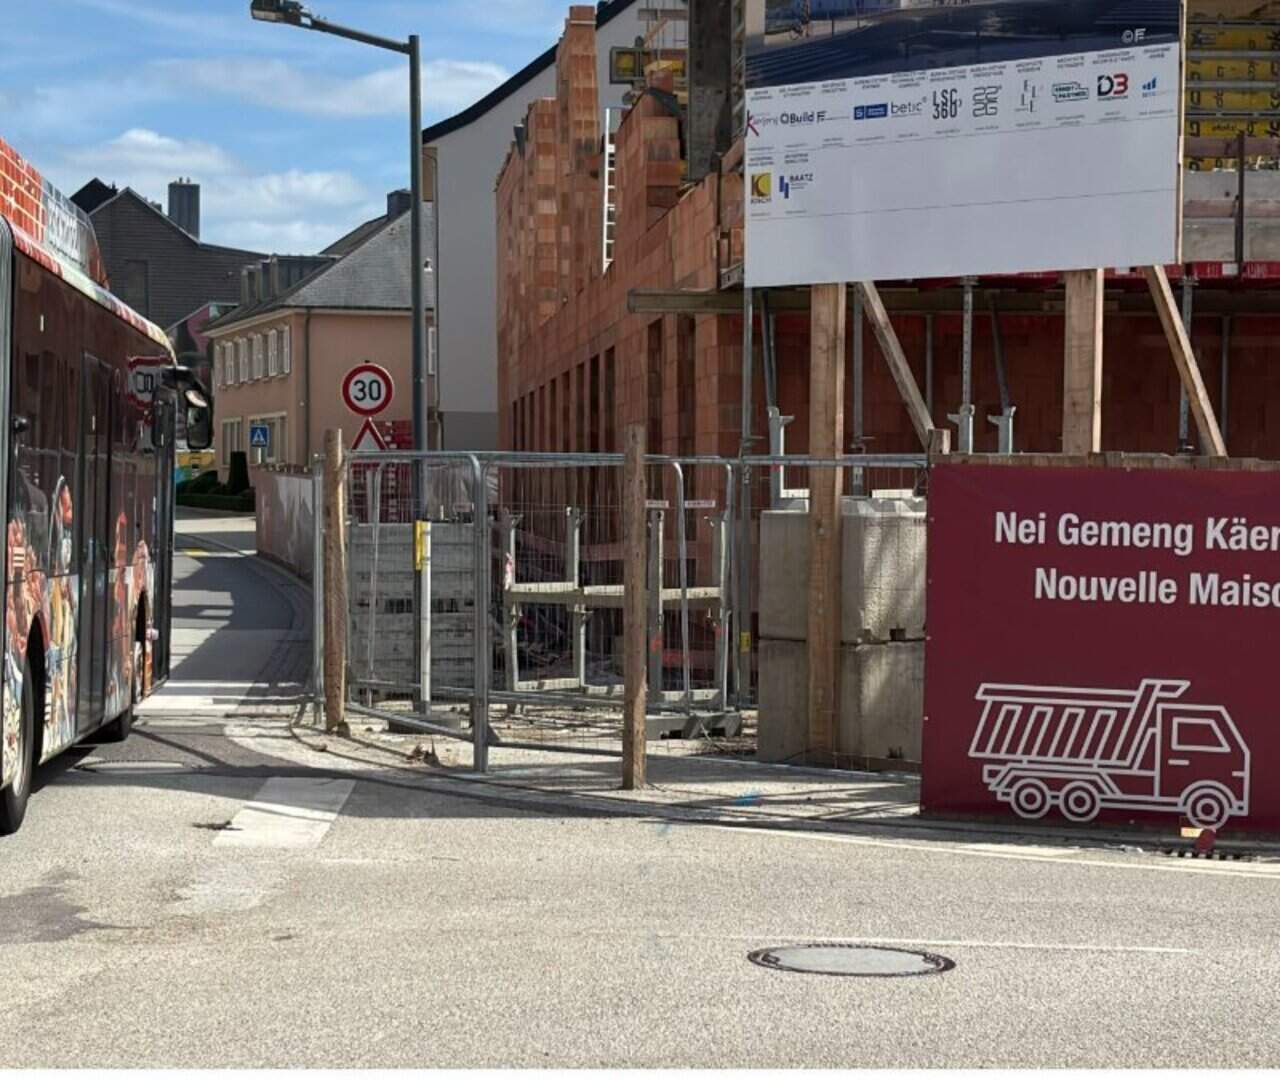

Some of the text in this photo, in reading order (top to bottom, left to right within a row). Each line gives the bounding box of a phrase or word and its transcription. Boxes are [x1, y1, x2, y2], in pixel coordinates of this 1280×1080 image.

[353, 379, 382, 402] 30
[994, 511, 1047, 545] Nei
[1057, 512, 1194, 556] Gemeng
[1034, 567, 1178, 604] Nouvelle
